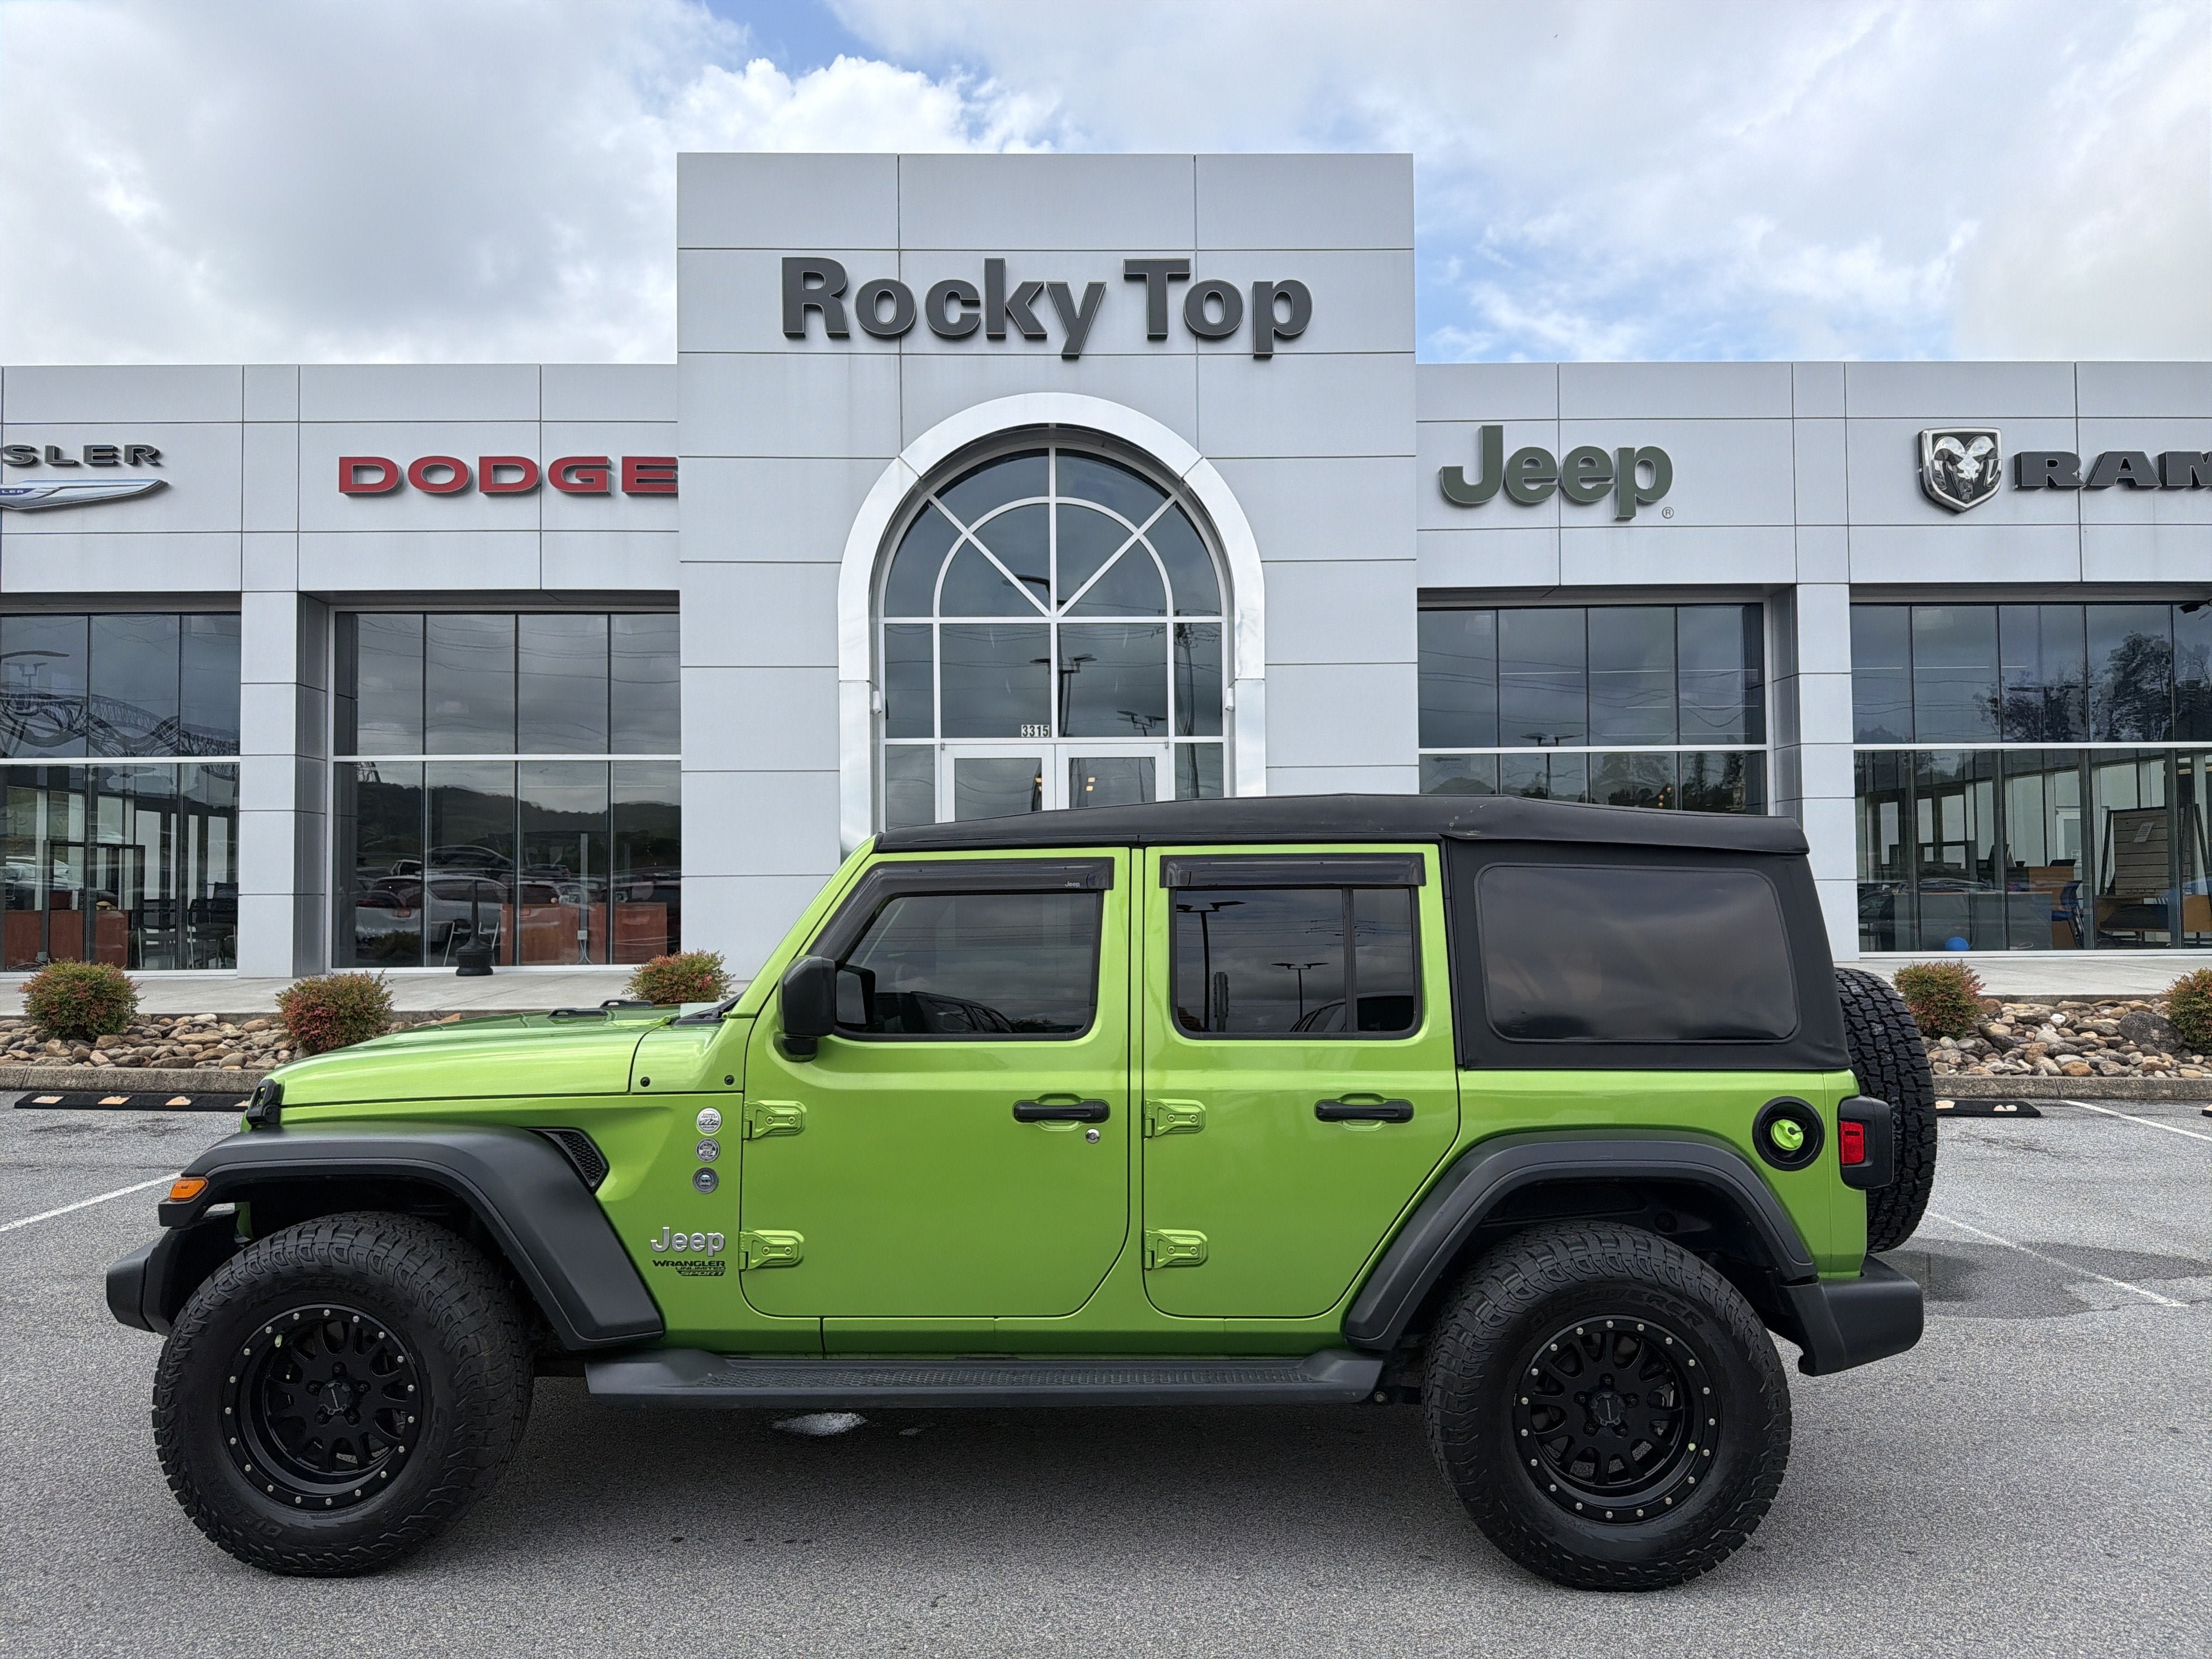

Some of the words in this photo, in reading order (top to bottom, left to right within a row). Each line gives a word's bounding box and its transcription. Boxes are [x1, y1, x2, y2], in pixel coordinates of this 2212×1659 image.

[781, 256, 1107, 359] Rocky
[1122, 258, 1313, 358] Top
[0, 444, 160, 466] SLER
[1439, 425, 1674, 521] Jeep
[2014, 450, 2212, 490] RAM
[338, 455, 678, 496] DODGE
[1022, 725, 1048, 737] 3315
[650, 1226, 725, 1256] Jeep
